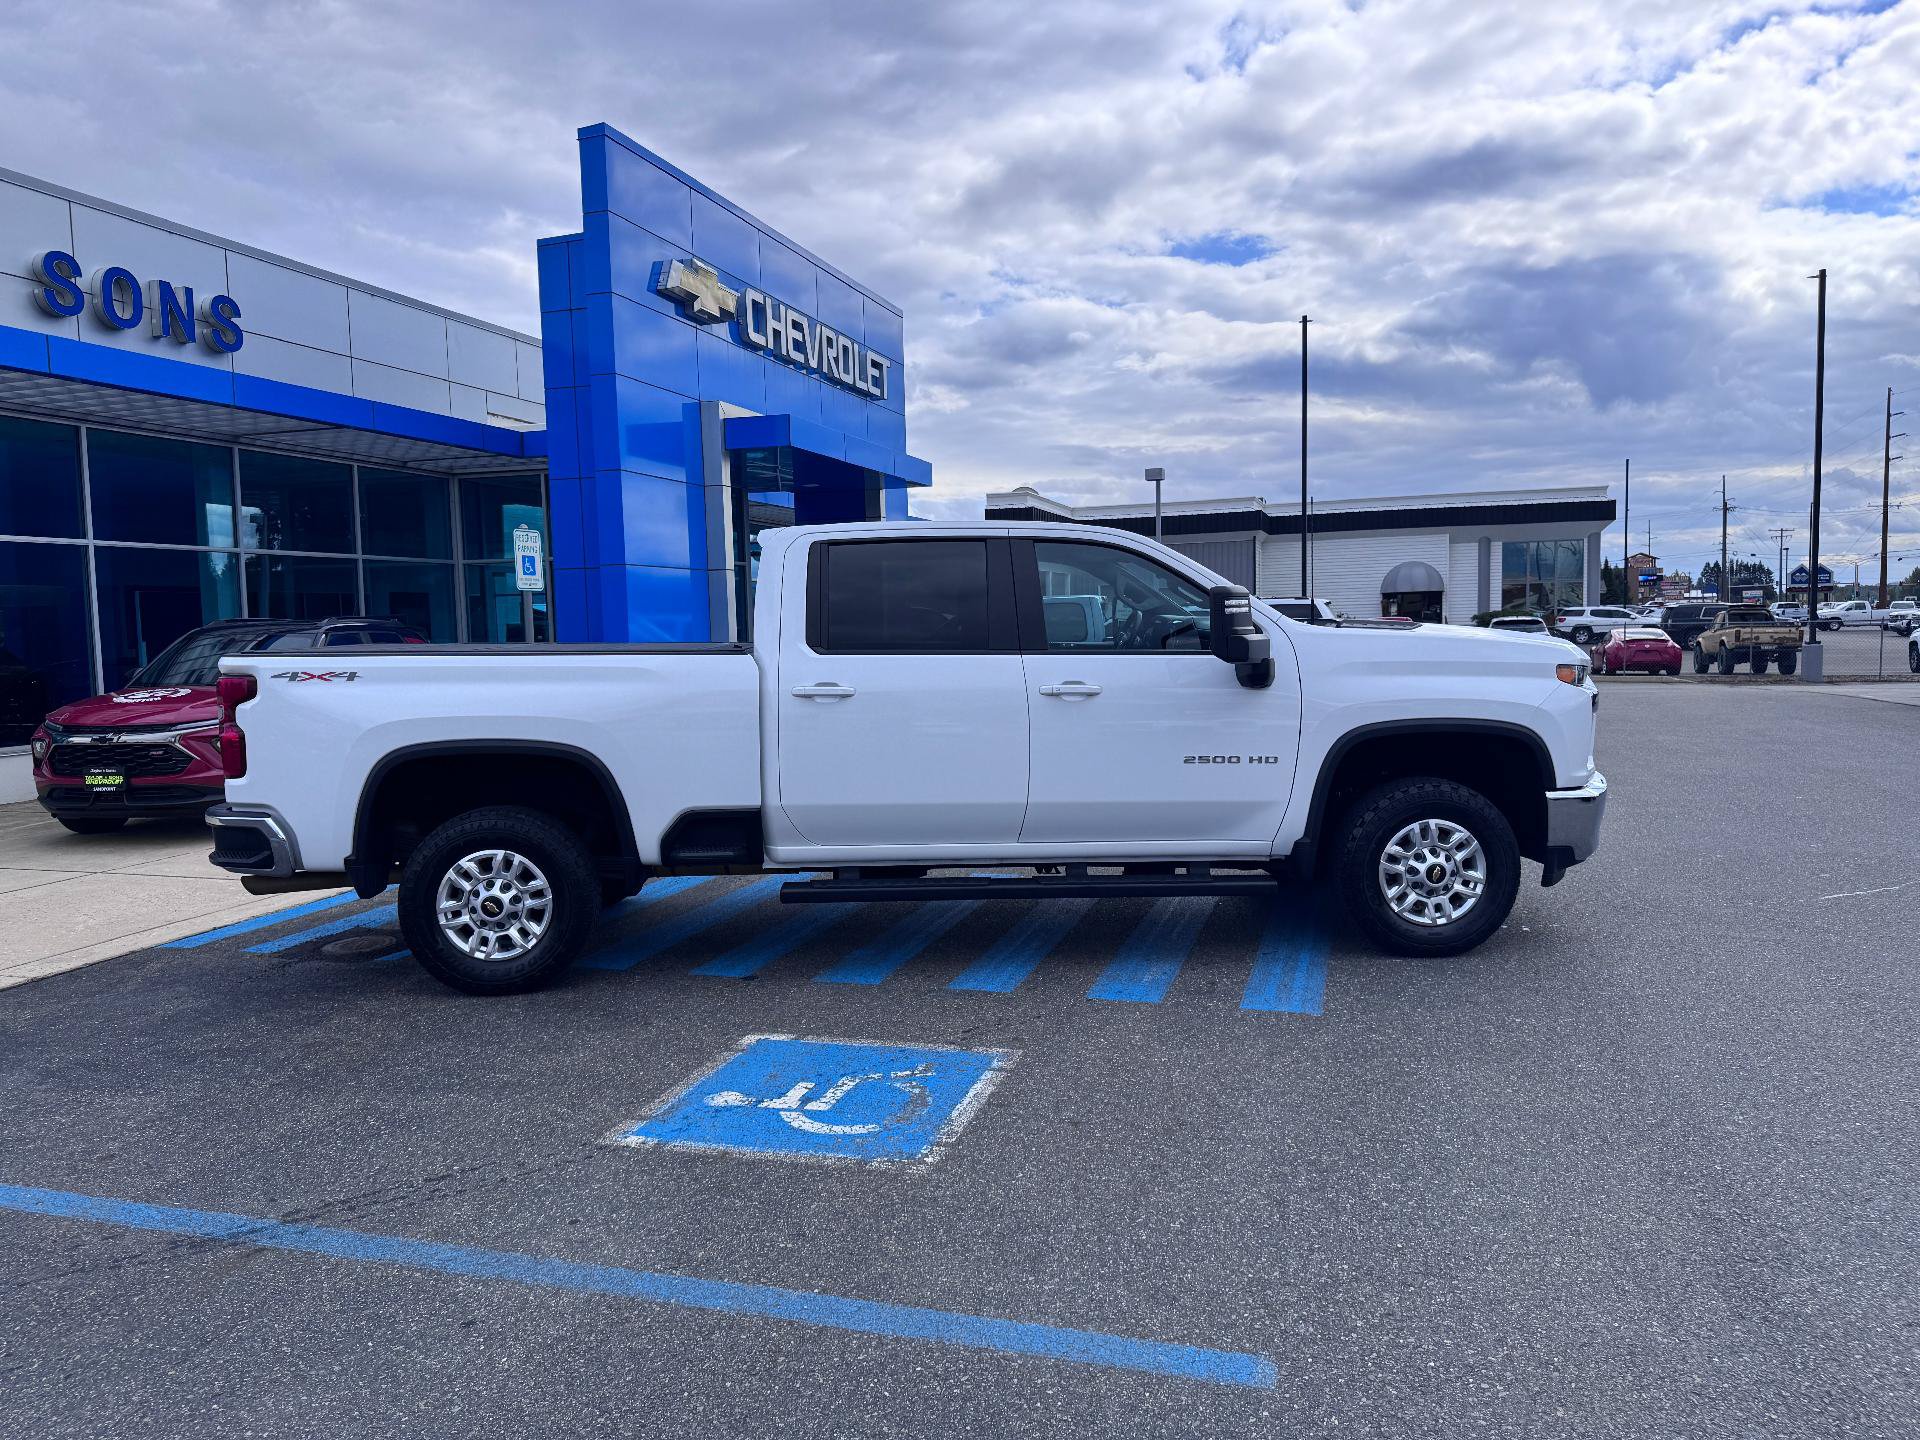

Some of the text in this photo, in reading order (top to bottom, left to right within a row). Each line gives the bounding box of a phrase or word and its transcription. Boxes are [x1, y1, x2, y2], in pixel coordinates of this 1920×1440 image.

[33, 250, 243, 353] SONS
[740, 287, 891, 400] CHEVROLET
[1183, 755, 1279, 764] 2500 HD
